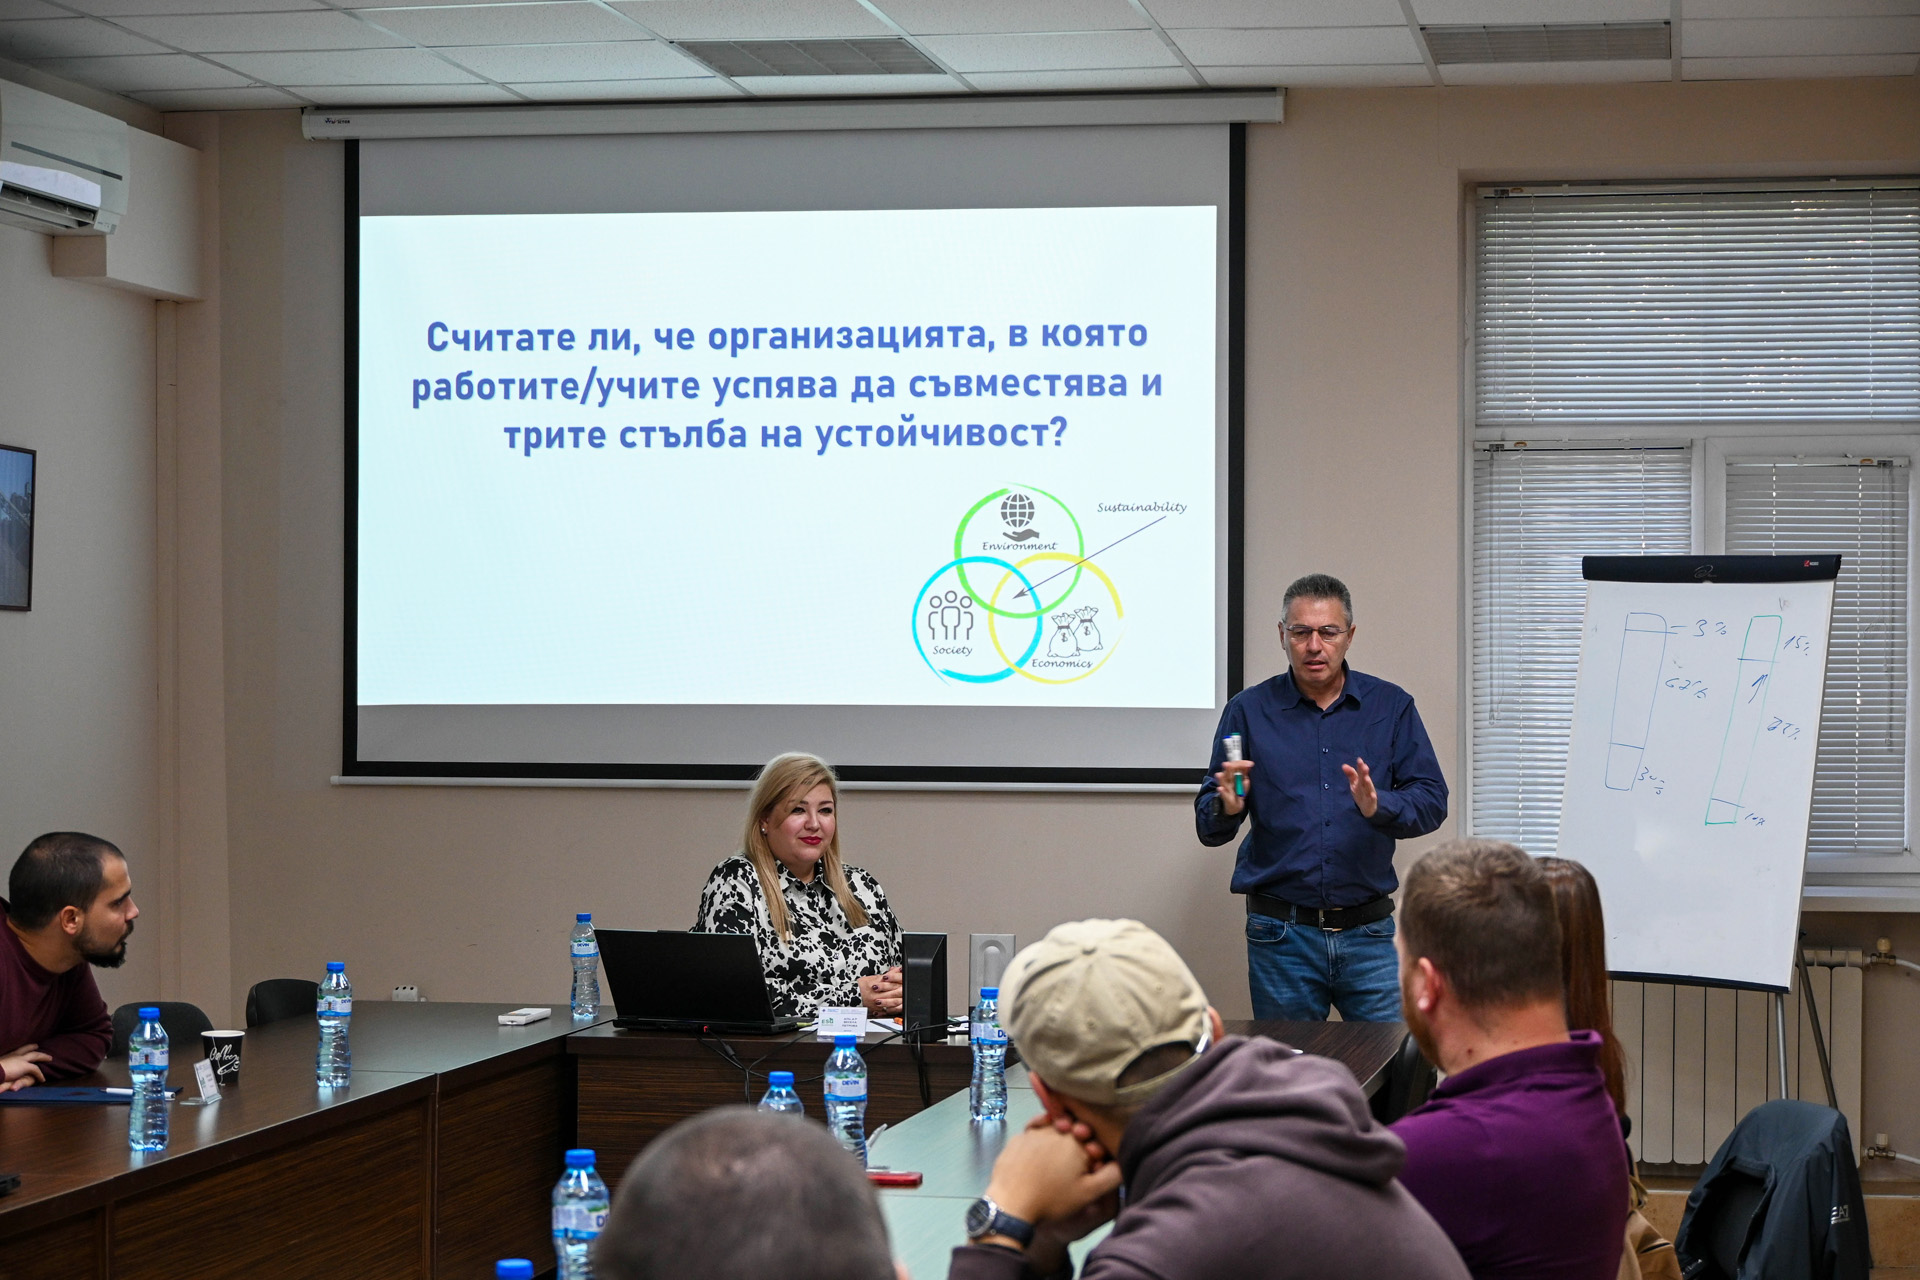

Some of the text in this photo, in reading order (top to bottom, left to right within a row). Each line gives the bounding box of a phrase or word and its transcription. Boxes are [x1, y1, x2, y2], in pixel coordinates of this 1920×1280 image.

[427, 321, 1148, 358] Считате ли, че организацията, в която
[412, 366, 1162, 409] работите/учите успява да съвместява и
[503, 413, 1068, 457] трите стълба на устойчивост?
[1097, 502, 1188, 515] Sustainability
[982, 541, 1059, 551] Environment
[932, 645, 973, 657] Society
[1031, 658, 1093, 669] Economics
